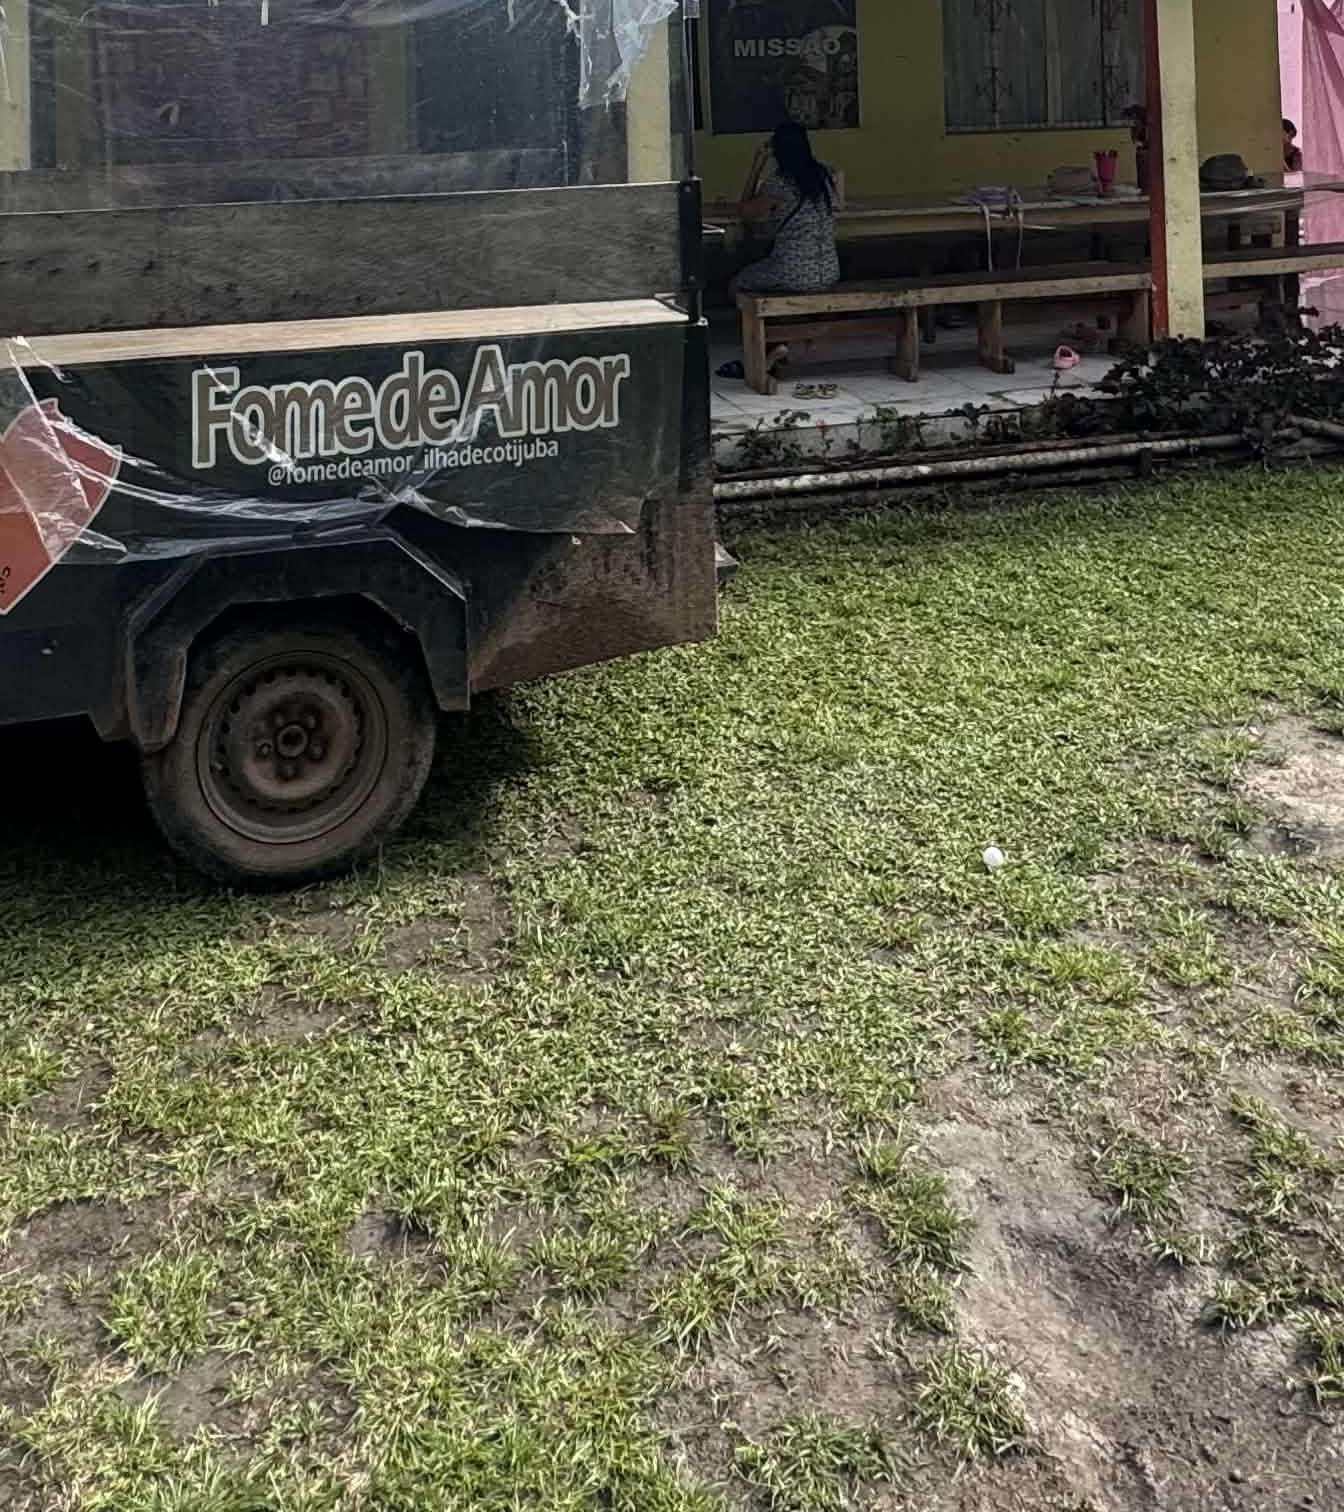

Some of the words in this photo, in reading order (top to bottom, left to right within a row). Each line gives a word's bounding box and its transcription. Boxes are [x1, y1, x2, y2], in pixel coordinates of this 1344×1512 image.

[192, 366, 376, 469] Fome
[376, 350, 461, 450] de
[457, 345, 631, 442] Amor
[267, 438, 560, 486] @fomedeamor_ilhadecotijuba
